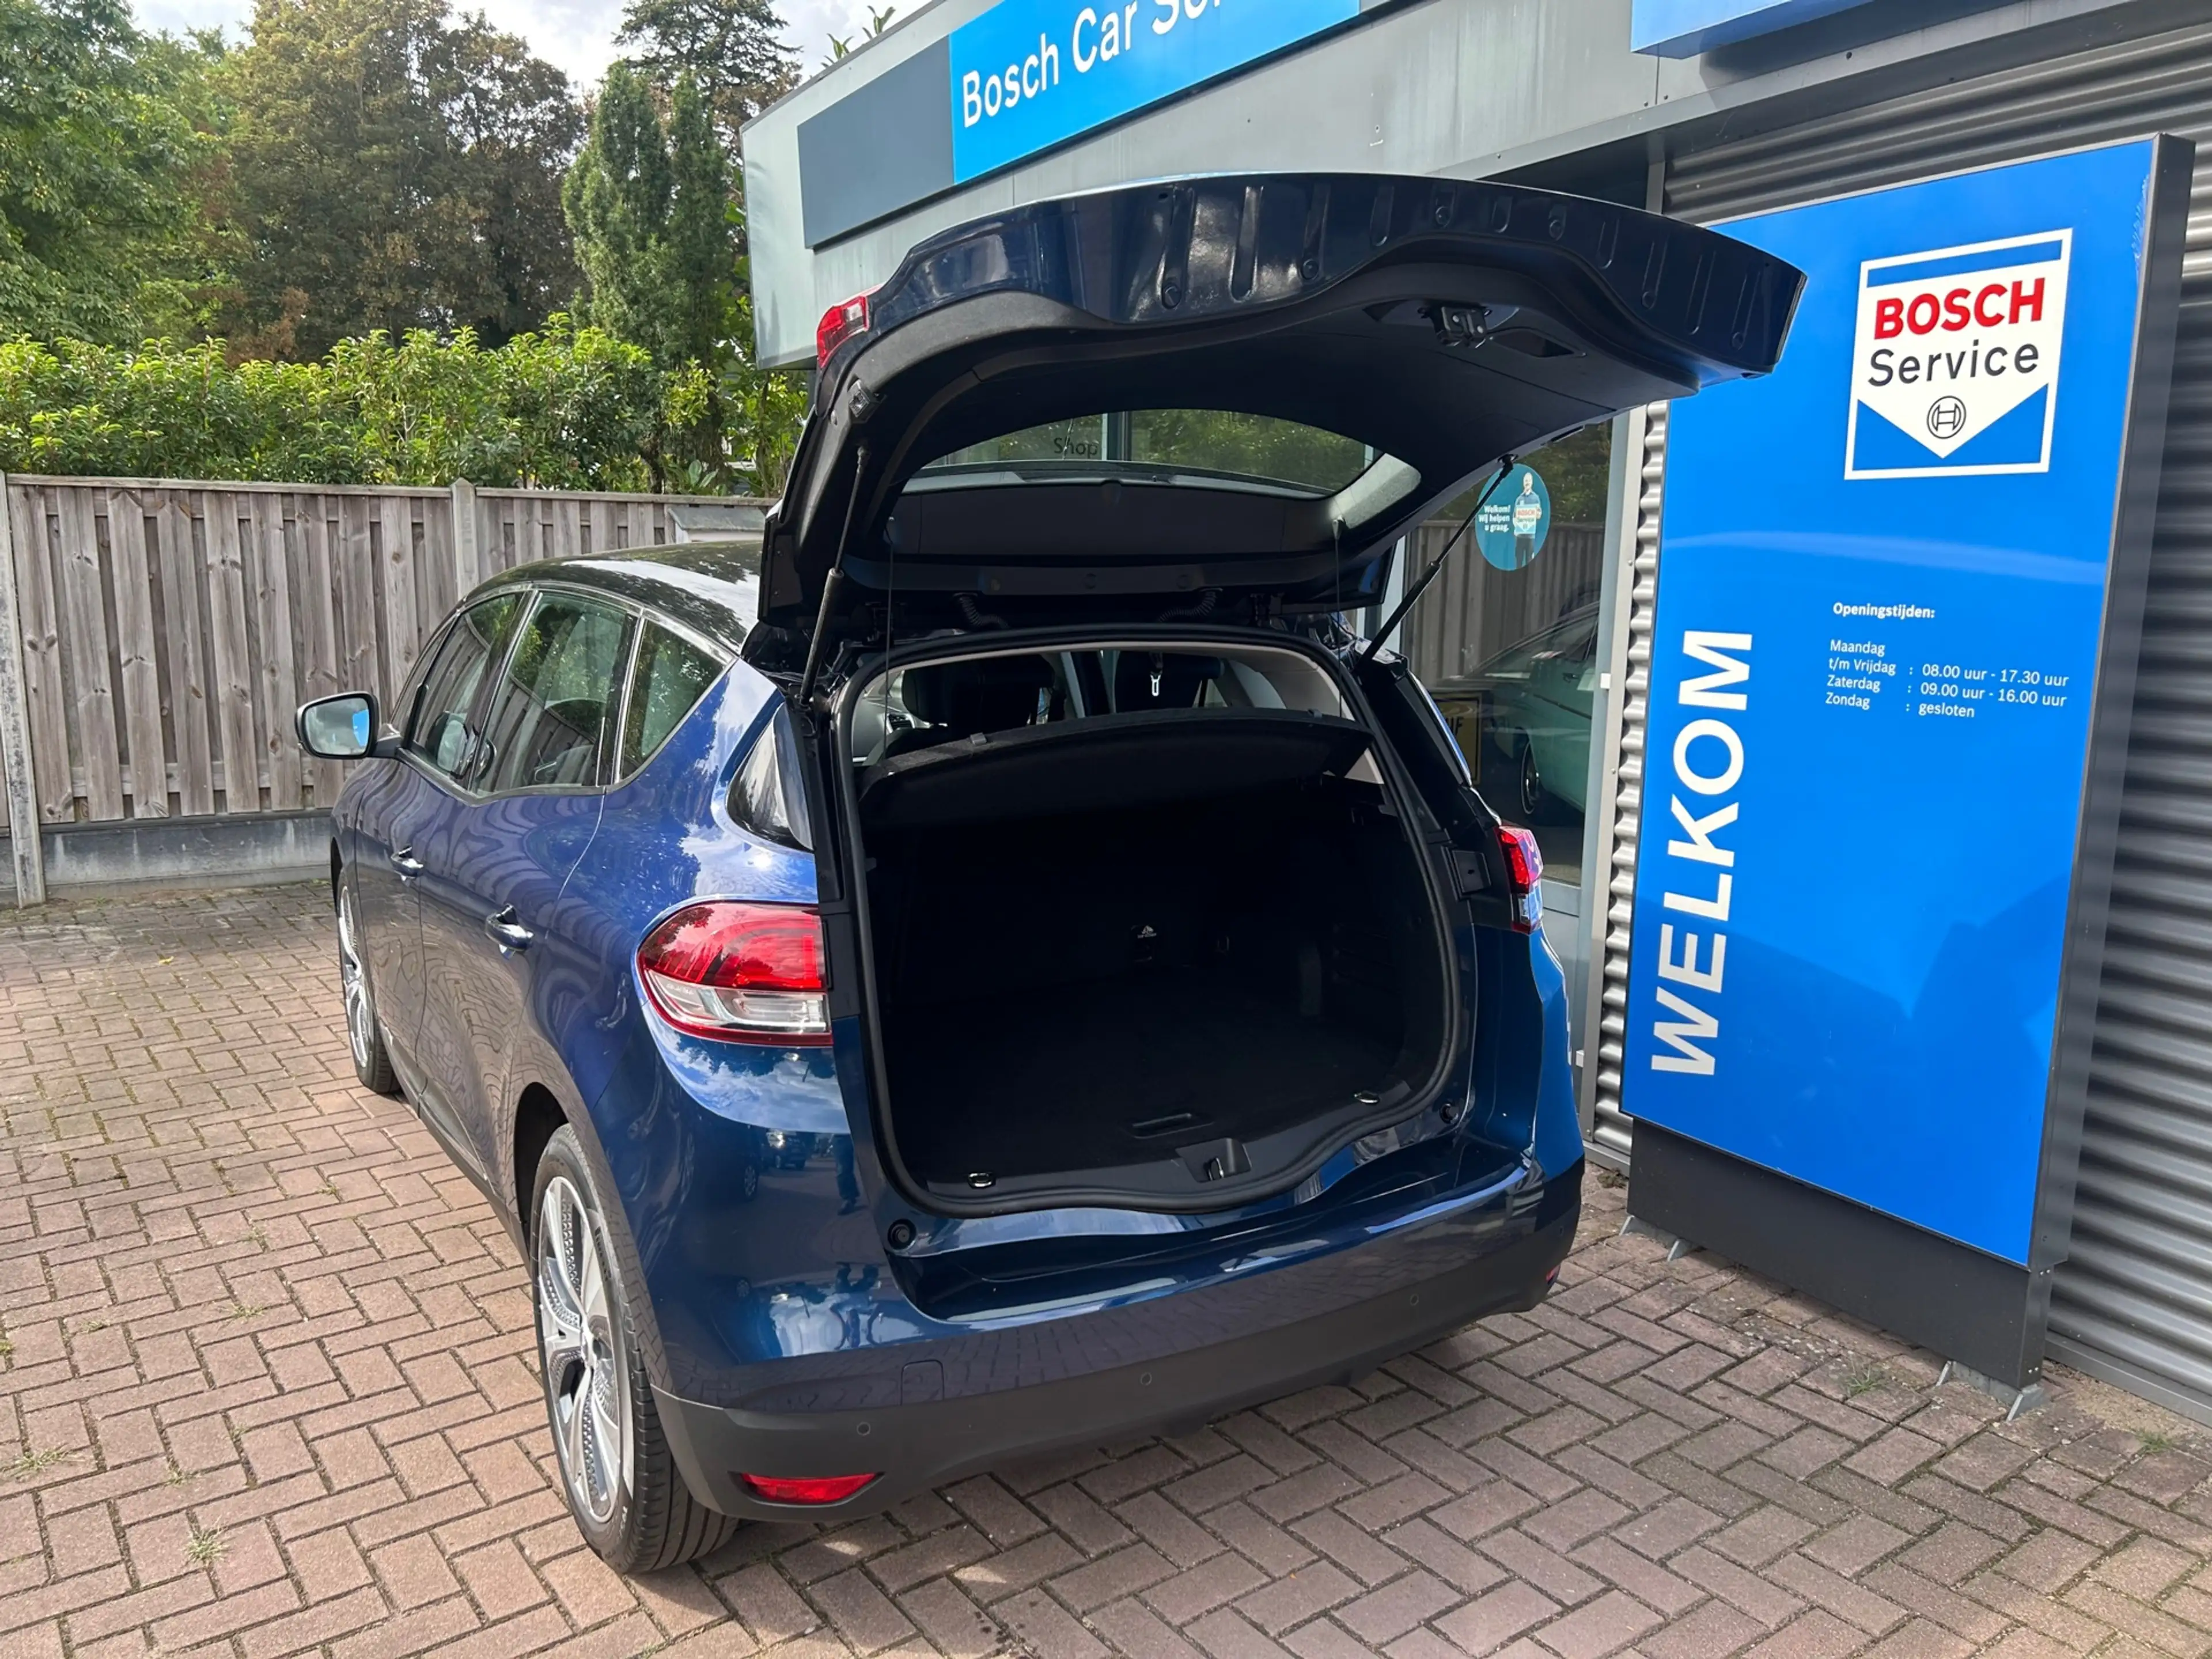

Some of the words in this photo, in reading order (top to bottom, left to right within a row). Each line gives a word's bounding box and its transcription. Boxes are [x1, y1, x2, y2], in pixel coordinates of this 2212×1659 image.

[963, 33, 1059, 128] Bosch
[1072, 0, 1138, 73] Car
[1874, 277, 2045, 340] BOSCH
[1868, 339, 2039, 387] Service
[1054, 437, 1098, 459] Shop
[1832, 601, 1936, 620] Openingstijden:
[1830, 639, 1885, 657] Maandag
[1828, 657, 1850, 671] t/m
[1854, 659, 1896, 676] Vrijdag
[1922, 663, 1960, 679] 08.00
[1964, 669, 1987, 680] uur
[2000, 669, 2040, 685] 17.30
[2044, 675, 2069, 687] uur
[1825, 692, 1870, 710] Zondag
[1918, 702, 1975, 718] gesloten
[1827, 675, 1881, 693] Zaterdag
[1921, 681, 1959, 697] 09.00
[1962, 688, 1986, 699] uur
[1998, 688, 2038, 704] 16.00
[2042, 695, 2067, 707] uur
[1651, 630, 1753, 1075] WELKOM
